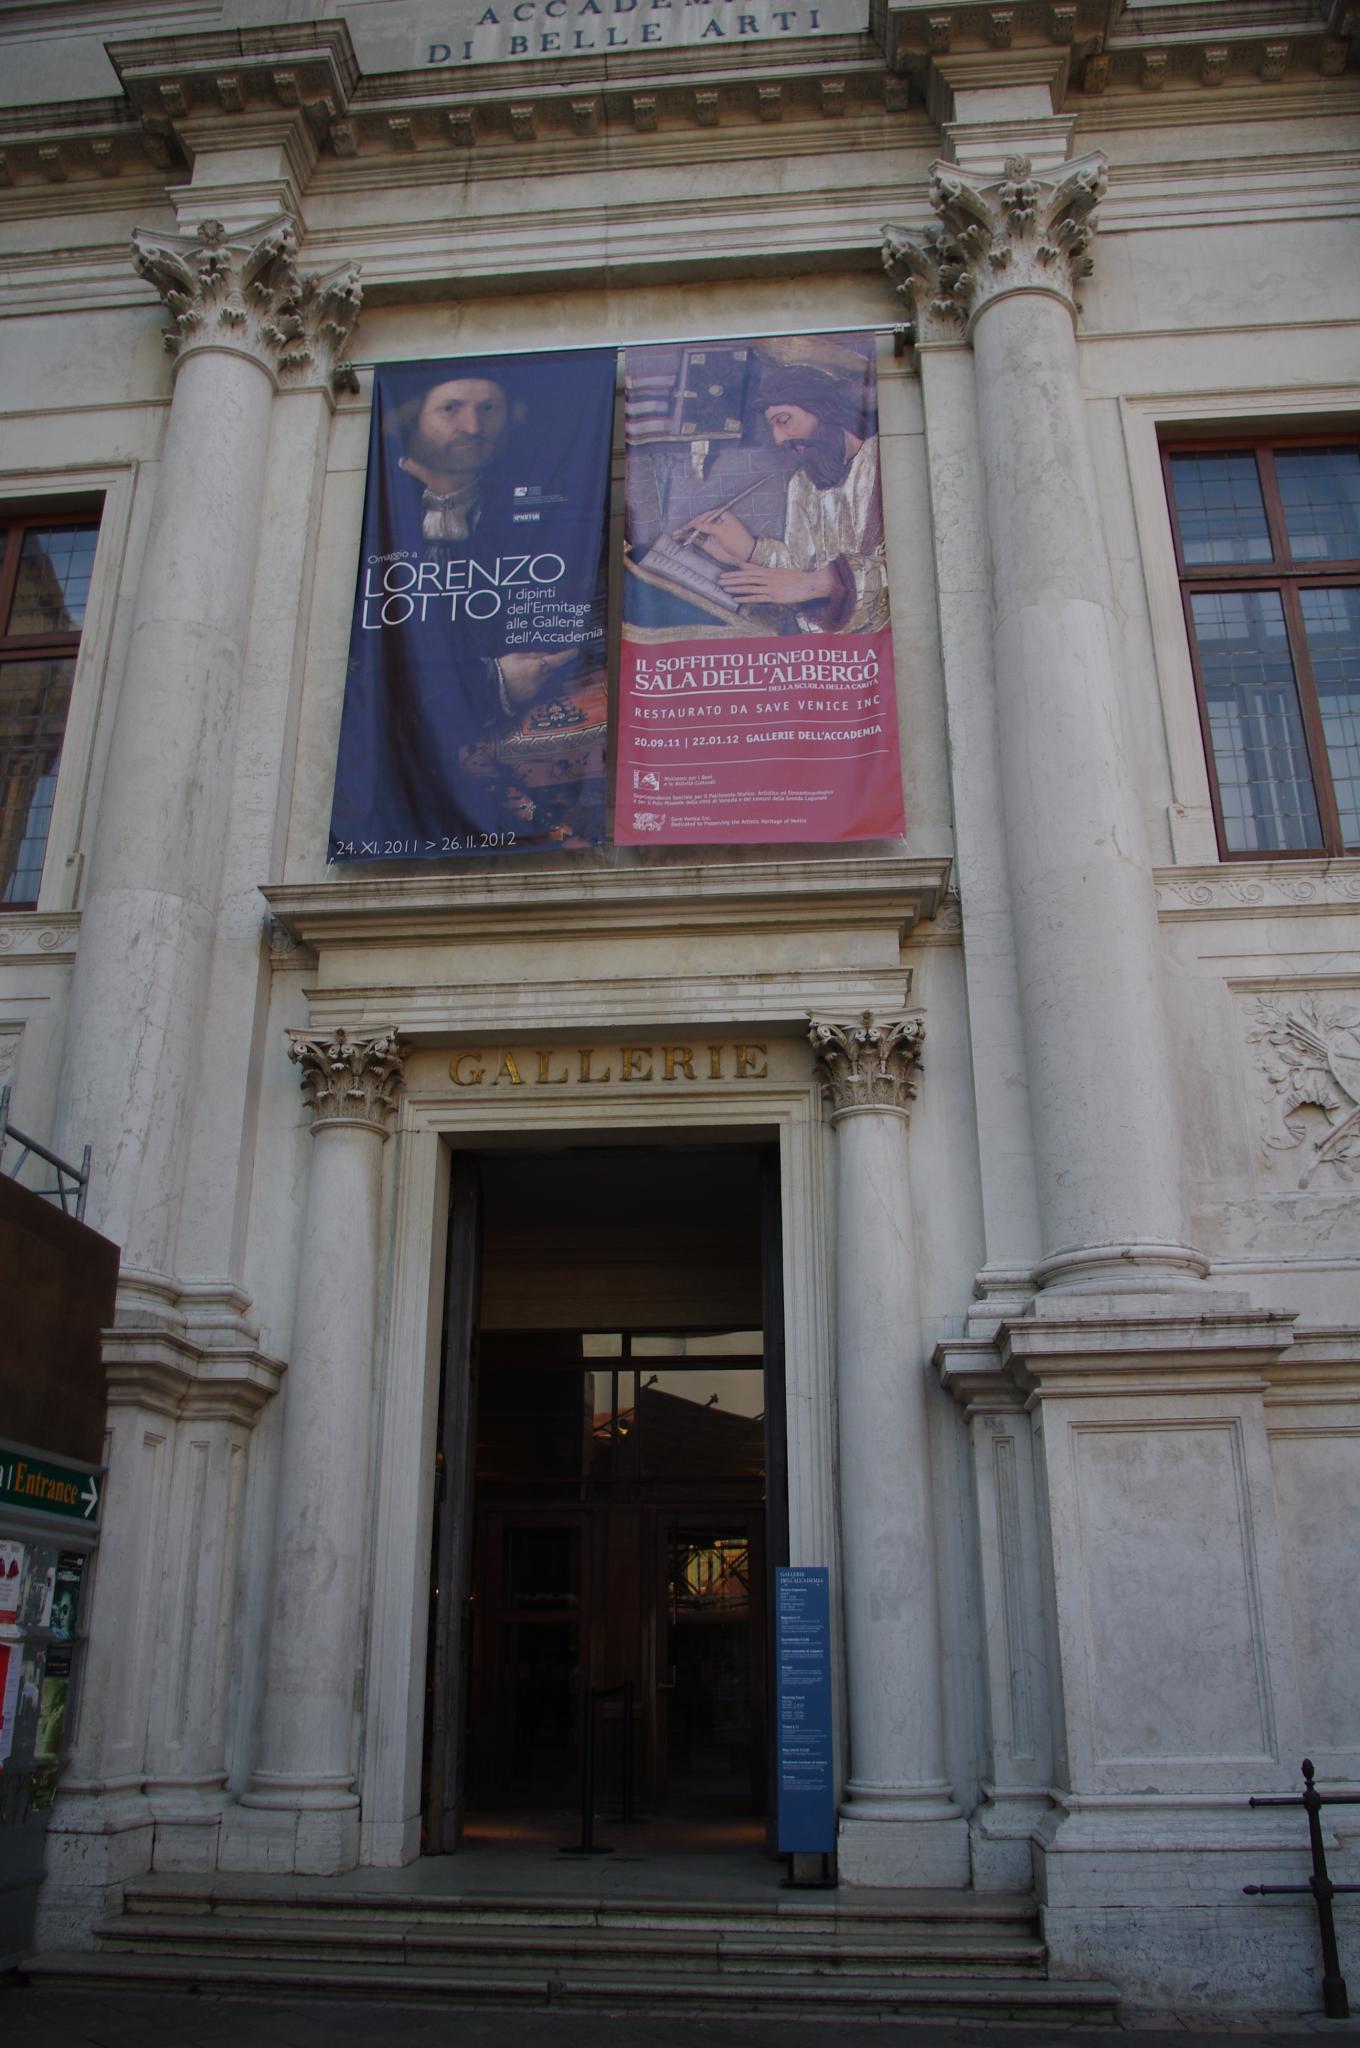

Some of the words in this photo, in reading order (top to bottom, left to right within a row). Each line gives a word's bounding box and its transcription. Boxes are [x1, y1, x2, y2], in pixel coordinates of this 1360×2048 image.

[427, 40, 474, 64] DI
[508, 23, 662, 56] BELLE
[701, 9, 821, 38] ARTI
[365, 553, 566, 598] LORENZO
[515, 586, 556, 601] dipinti
[362, 589, 501, 629] LOTTO
[507, 601, 592, 616] dell'Ermitage
[506, 617, 528, 630] alle
[532, 615, 584, 628] Gallerie
[505, 626, 604, 645] dell'Accademia
[636, 658, 653, 673] IL
[655, 653, 744, 673] SOFFITTO
[747, 648, 815, 667] LIGNEO
[818, 648, 877, 664] DELLA
[635, 672, 697, 691] SALA
[702, 662, 879, 688] DELL'ALBERGO
[768, 684, 794, 692] DELLA
[794, 682, 825, 690] SCUOLA
[825, 682, 850, 690] DELLA
[635, 705, 723, 719] RESTAURATO
[730, 704, 748, 714] DA
[756, 701, 790, 714] SAVE
[798, 700, 849, 711] VENICE
[857, 695, 880, 711] INC
[634, 737, 681, 748] 20.09.11
[692, 734, 740, 746] 22.01.12
[746, 731, 795, 743] GALLERIE
[798, 724, 882, 741] DELL'ACCADEMIA
[449, 1044, 768, 1087] GALLERIE
[14, 1462, 78, 1505] Entrance
